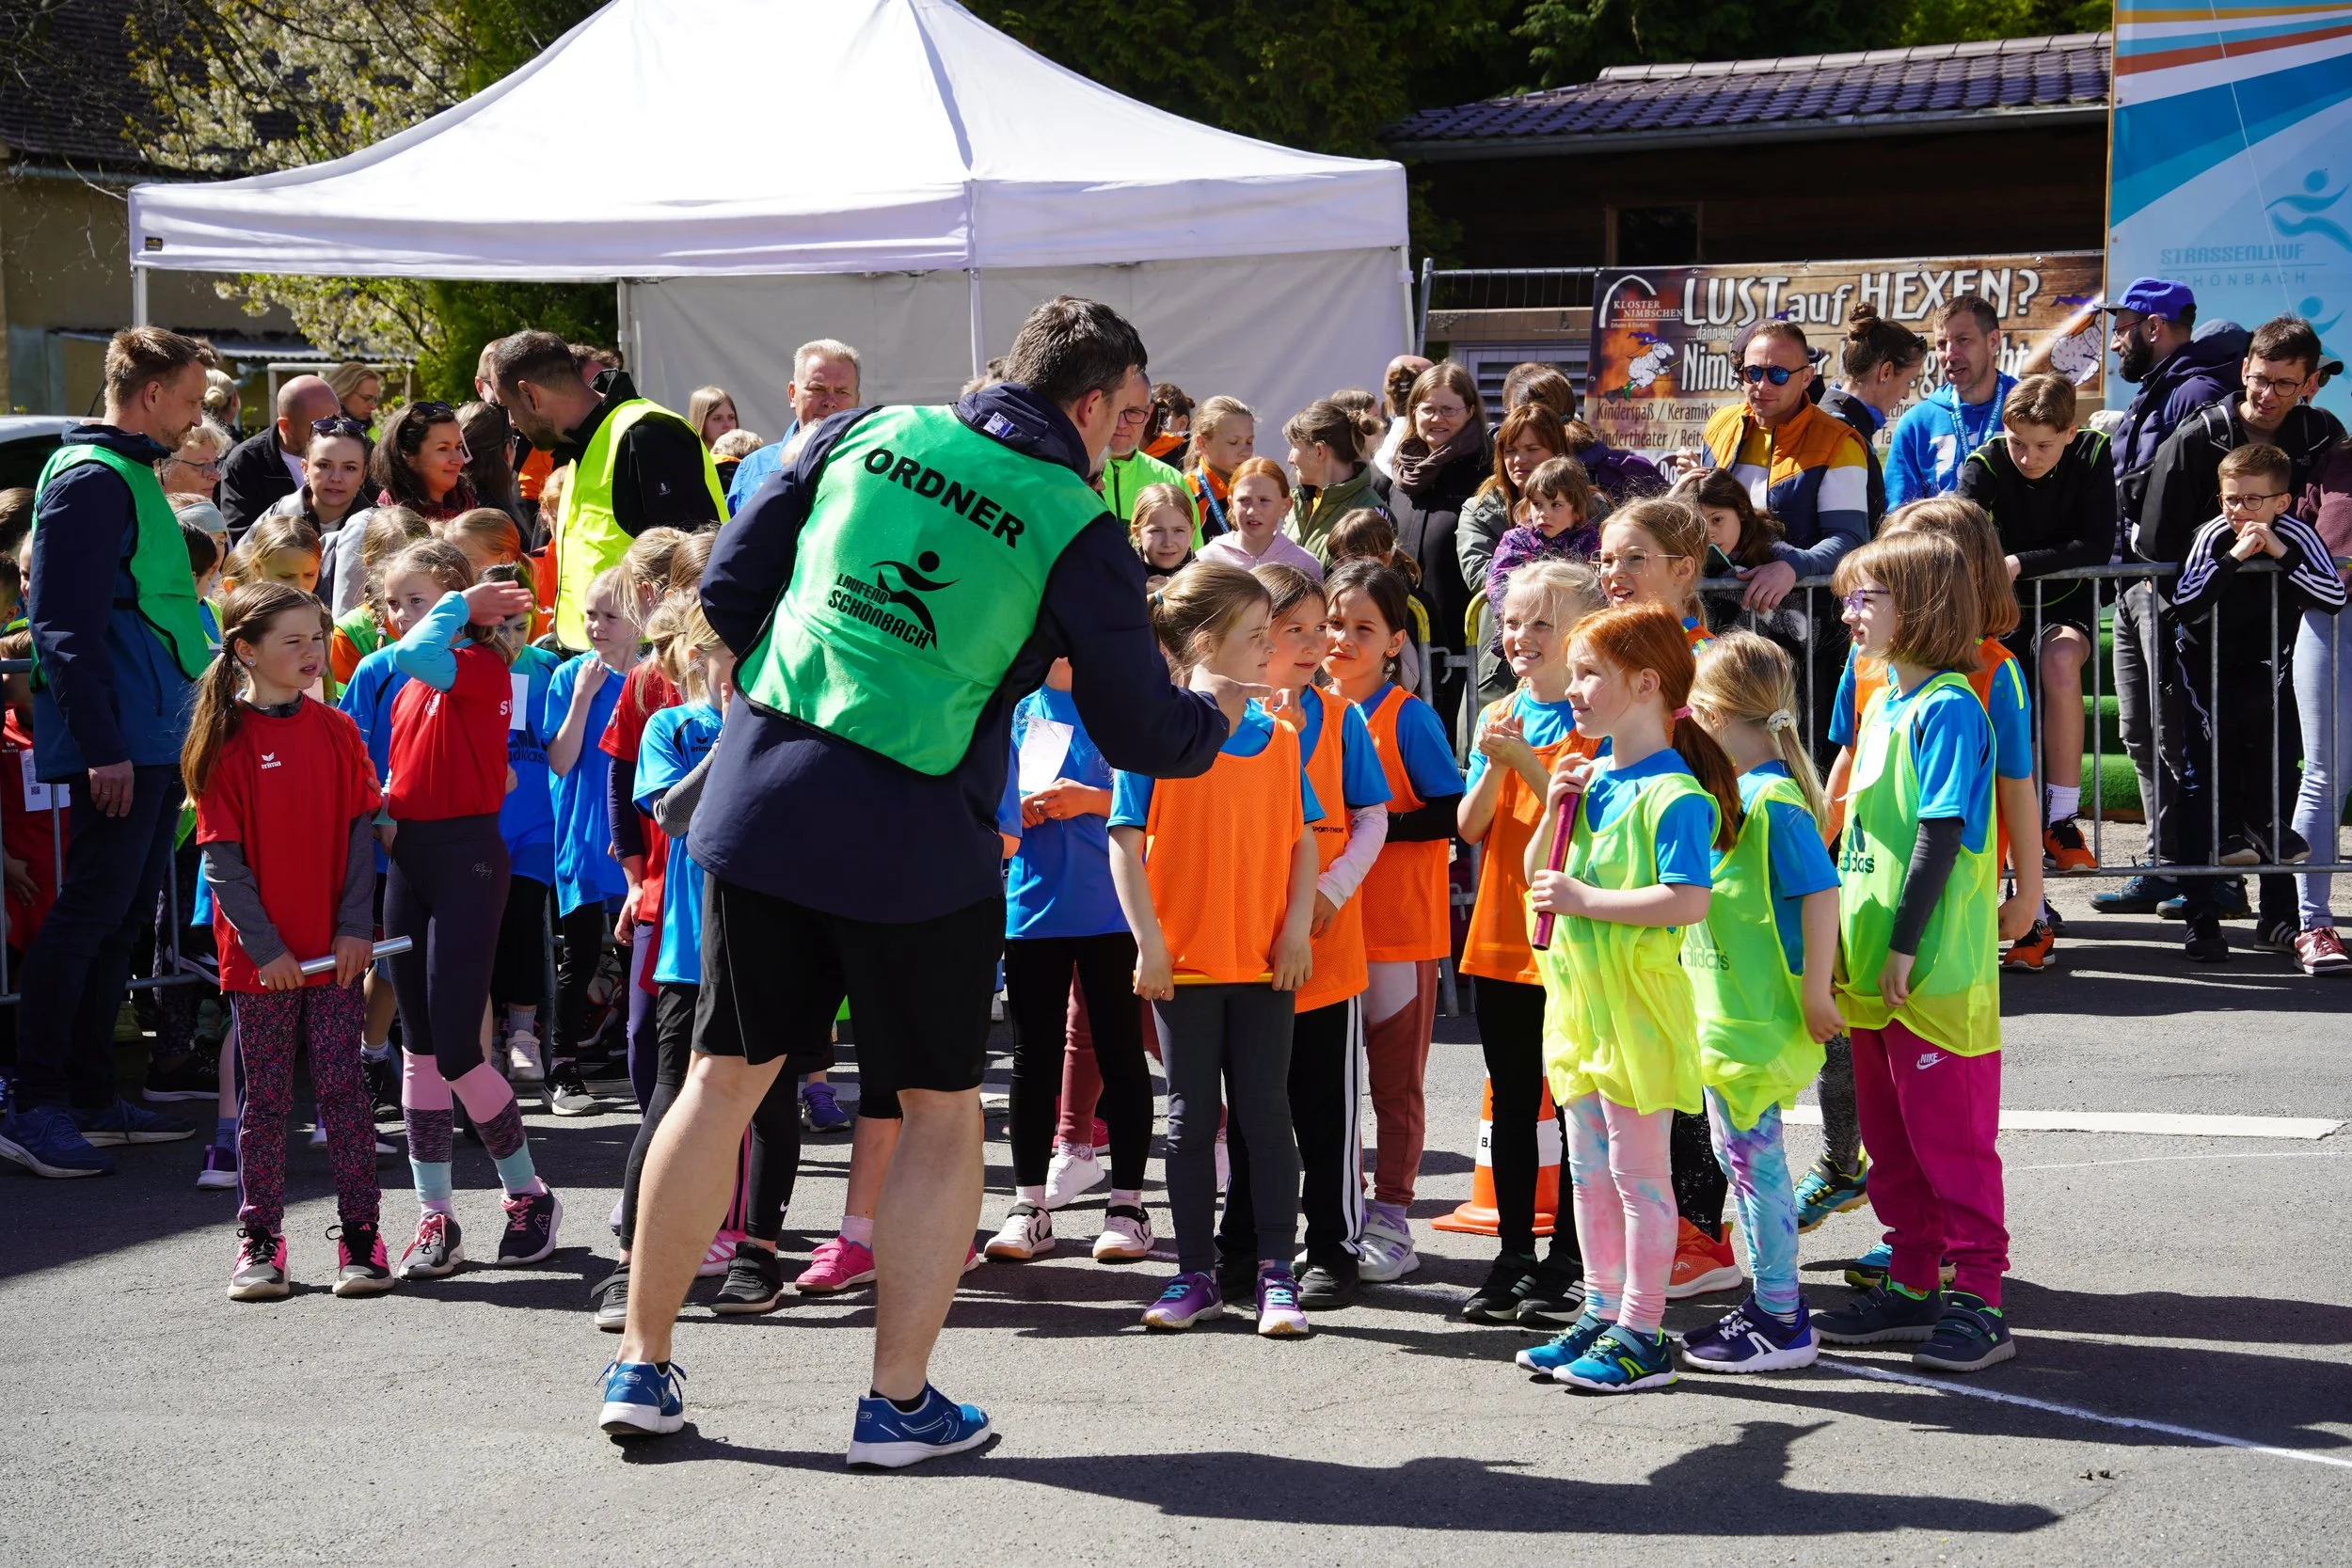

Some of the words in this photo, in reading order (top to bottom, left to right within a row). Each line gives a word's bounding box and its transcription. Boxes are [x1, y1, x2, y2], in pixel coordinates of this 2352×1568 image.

[2160, 243, 2305, 264] STRASSENLAUF
[1613, 300, 1661, 309] KLOSTER
[1683, 276, 1789, 326] LUST
[1788, 284, 1852, 325] auf
[1859, 267, 2041, 320] HEXEN?
[1624, 309, 1684, 318] NIMBSCHEN
[1720, 324, 1738, 341] auf
[1597, 402, 1655, 424] Kinderspaß
[864, 448, 1025, 549] ORDNER
[835, 573, 890, 605] LAUFEND
[828, 590, 933, 650] SCHÖNBACH
[1683, 947, 1729, 971] didas
[1920, 1052, 1939, 1064] NIKE
